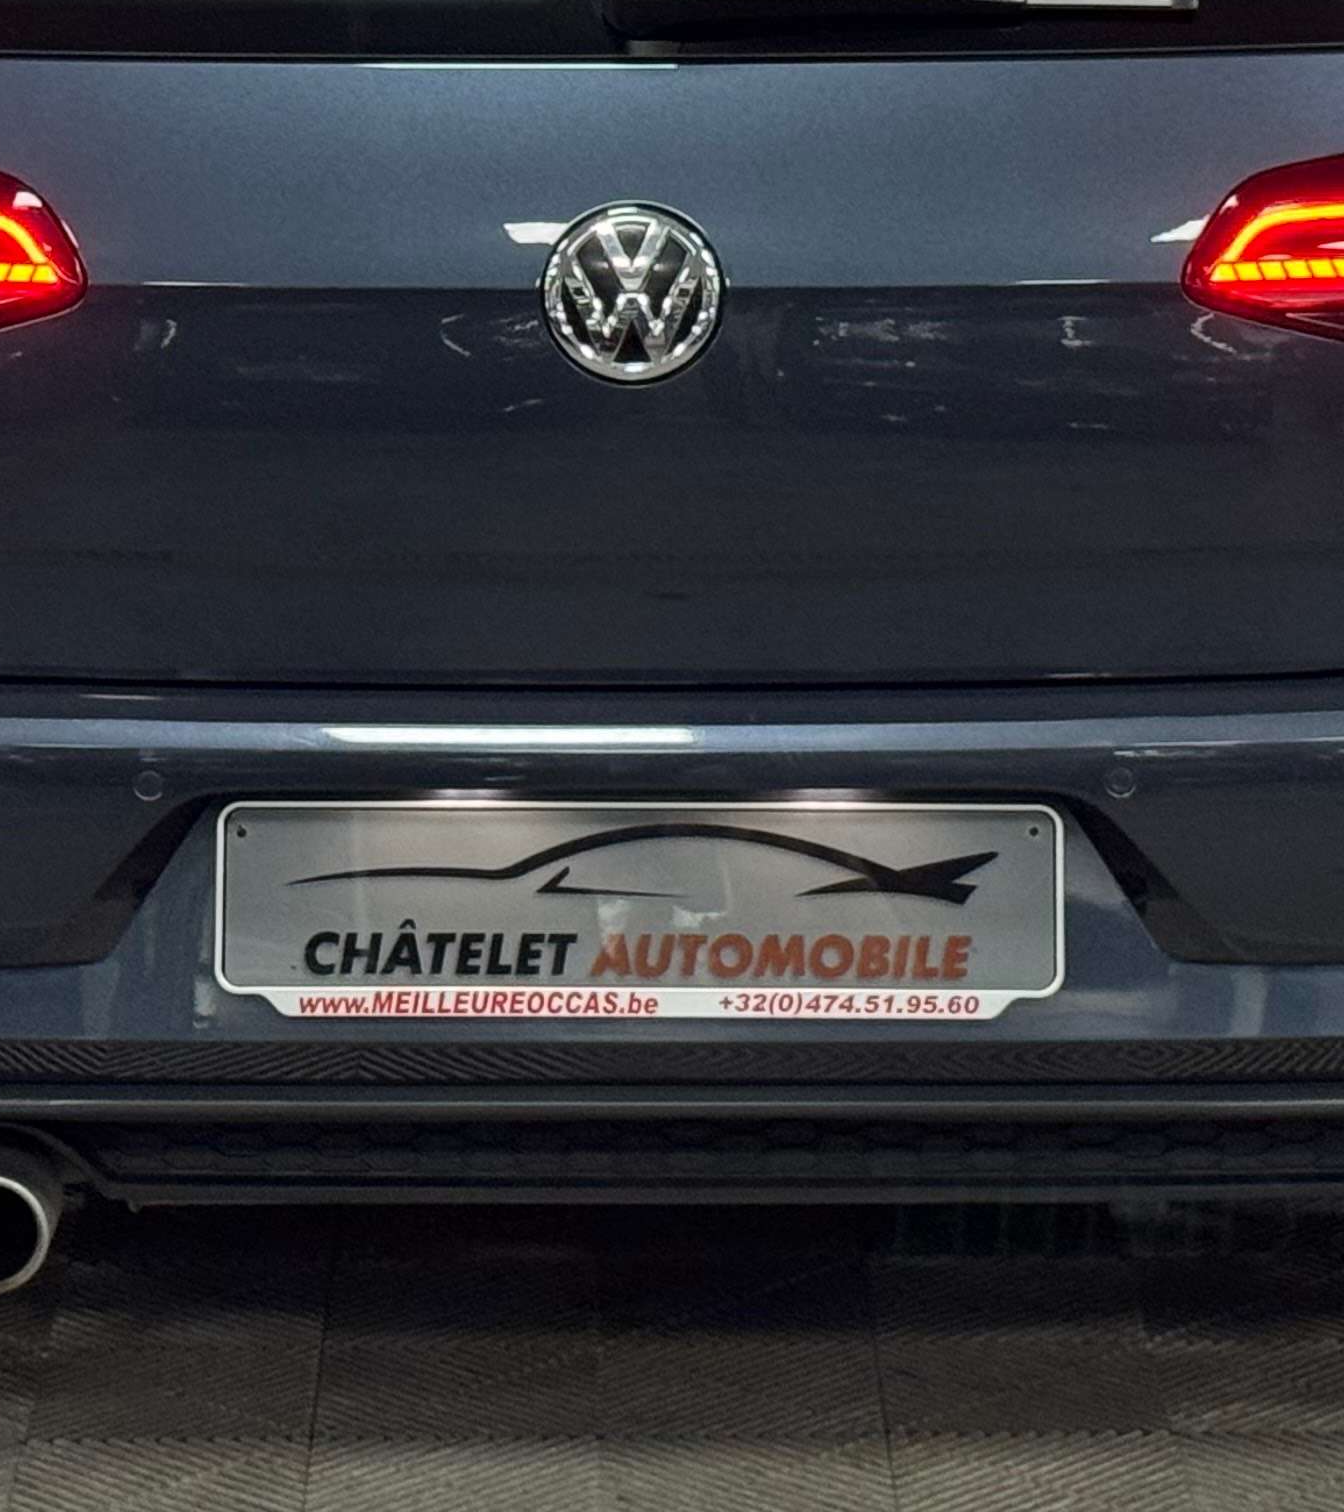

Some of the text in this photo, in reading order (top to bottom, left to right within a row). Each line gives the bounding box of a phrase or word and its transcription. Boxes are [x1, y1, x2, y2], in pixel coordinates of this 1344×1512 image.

[304, 919, 973, 980] CHÂTELET AUTOMOBILE
[299, 991, 658, 1015] www.MEILLEUREOCCAS.be
[718, 993, 980, 1016] +32(0)474.51.95.60
